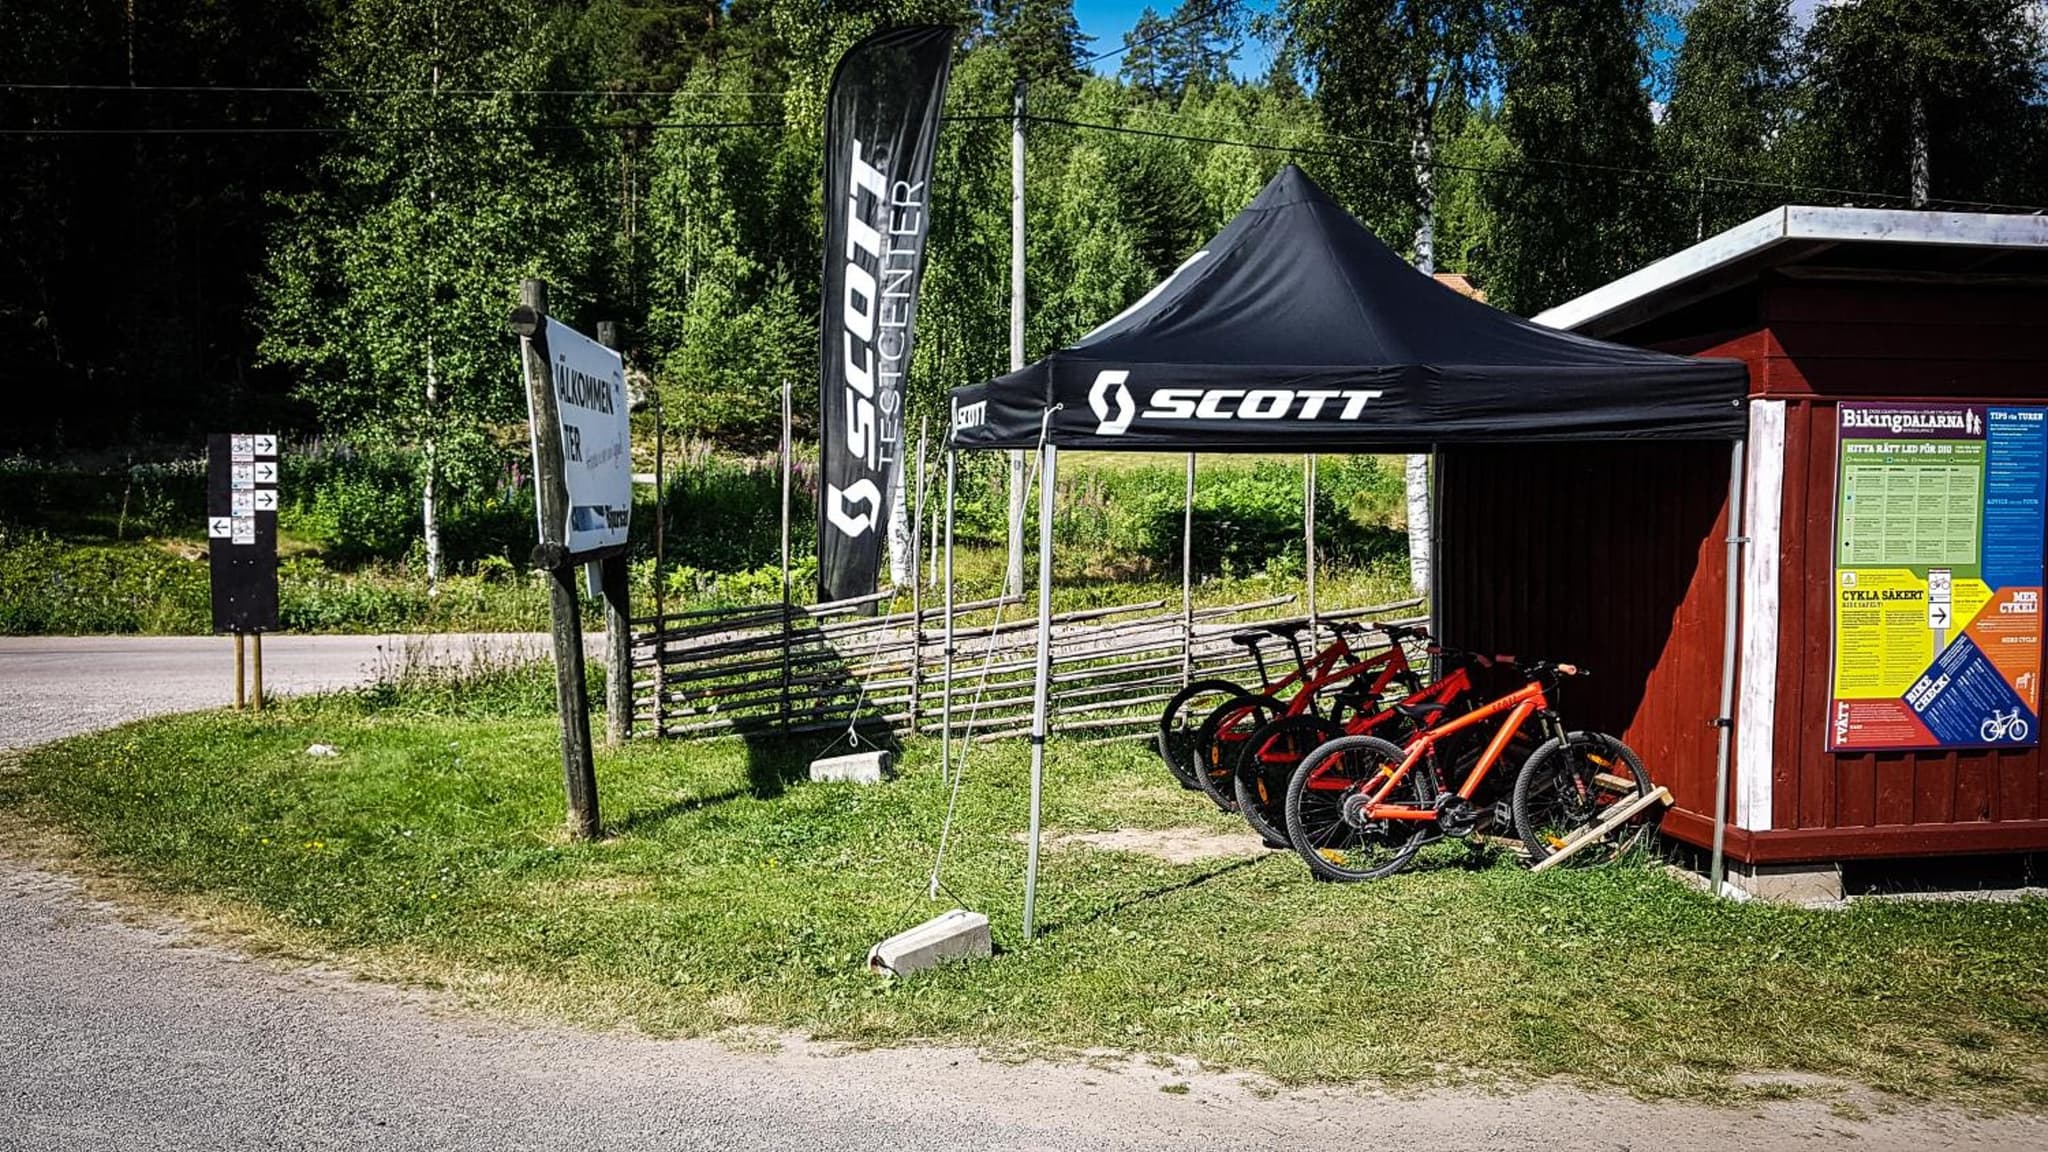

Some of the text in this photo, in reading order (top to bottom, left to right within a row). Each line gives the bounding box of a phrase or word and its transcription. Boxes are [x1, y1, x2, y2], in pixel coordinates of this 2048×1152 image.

[844, 138, 887, 471] SCOTT
[876, 179, 925, 472] TESTCENTER
[957, 400, 987, 430] SCOTT
[1140, 388, 1383, 420] SCOTT
[1990, 412, 2008, 420] TIPS
[563, 424, 582, 462] TER
[1847, 444, 1874, 453] HITTA
[1876, 442, 1900, 453] RÄTT
[1901, 444, 1918, 453] LED
[1919, 442, 1936, 454] FÖR
[1842, 587, 1924, 600] CYKLA SÄKERT
[2013, 591, 2038, 602] MER
[1905, 674, 1933, 704] BIKE
[1833, 701, 1849, 745] TVÄTT
